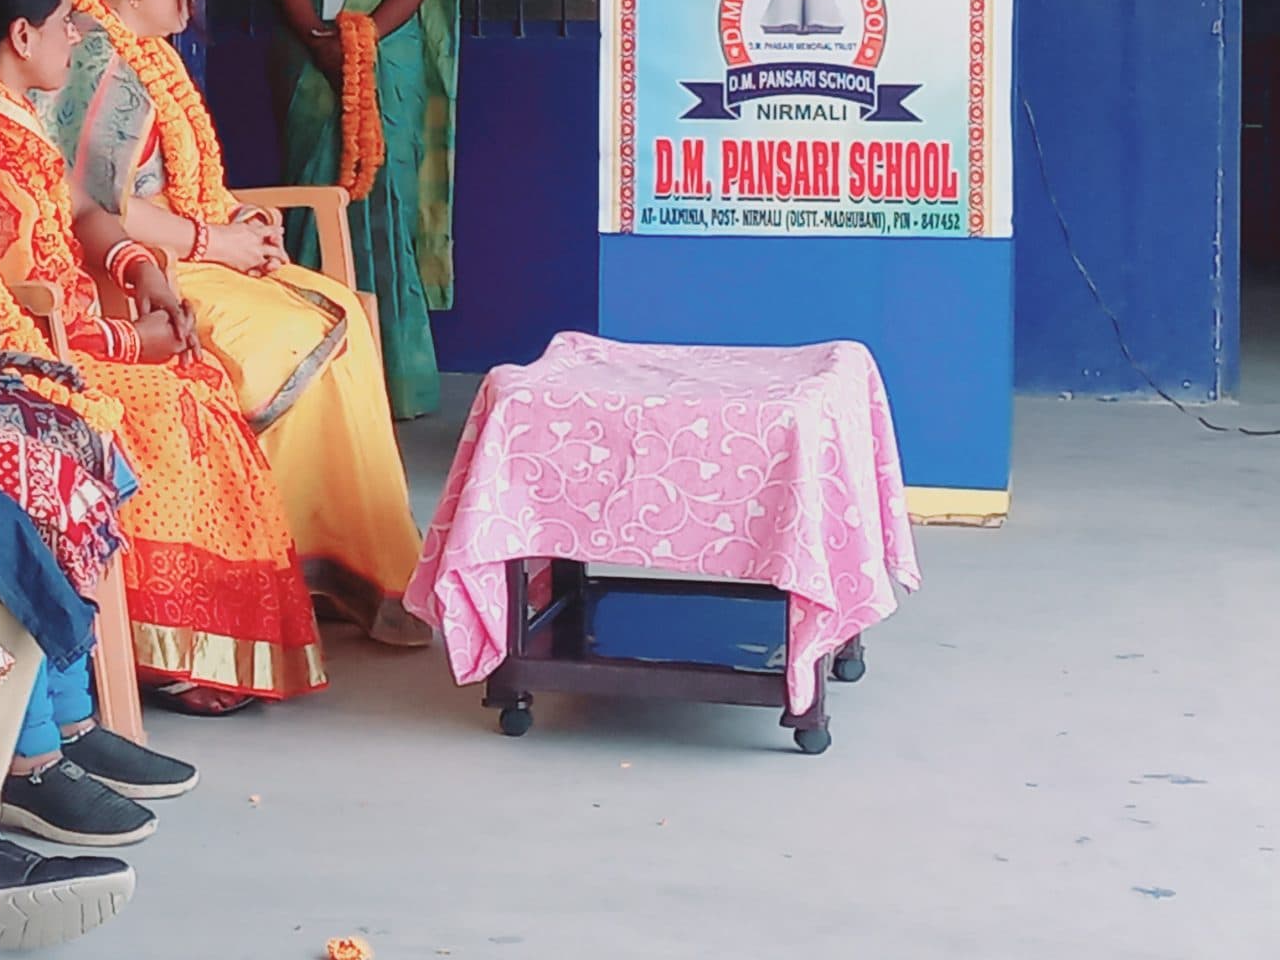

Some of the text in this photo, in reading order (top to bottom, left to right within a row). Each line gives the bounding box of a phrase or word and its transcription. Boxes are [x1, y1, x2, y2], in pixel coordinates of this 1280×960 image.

[729, 70, 874, 93] D.M. PANSARI SCHOOL
[757, 104, 848, 121] NIRMALI
[654, 138, 959, 203] D.M. PANSARI SCHOOL
[742, 209, 782, 227] NIRMALI
